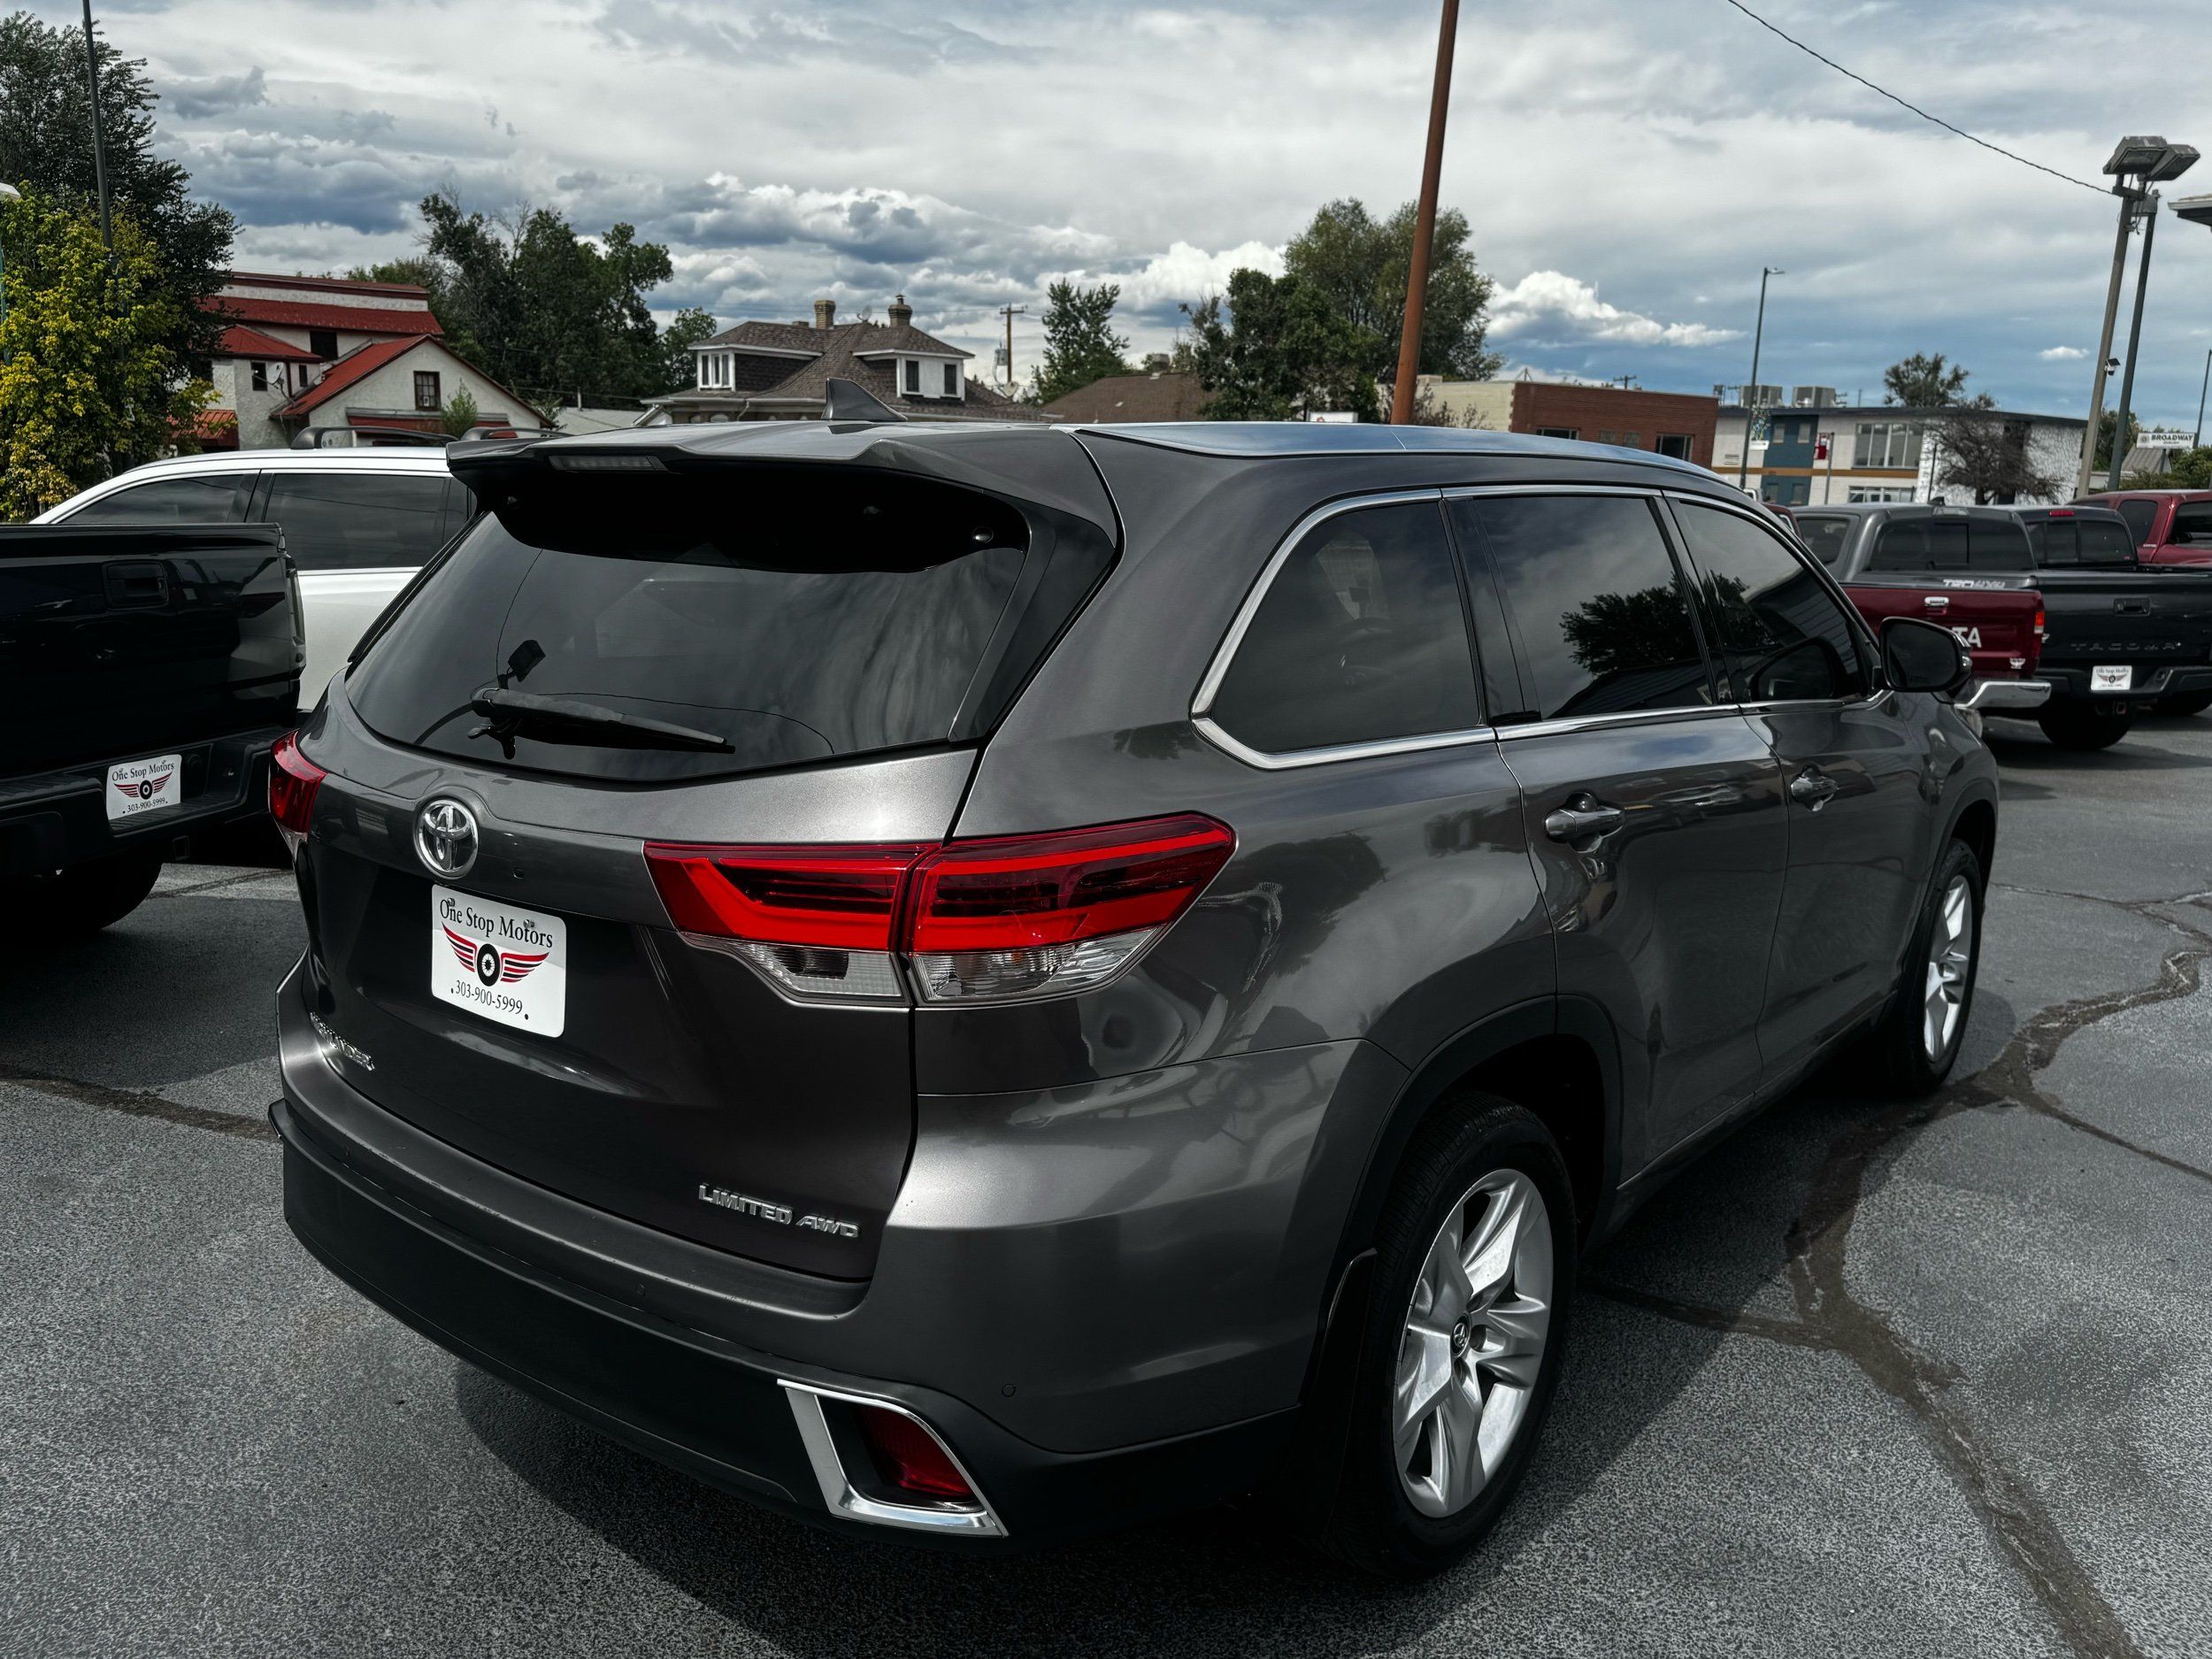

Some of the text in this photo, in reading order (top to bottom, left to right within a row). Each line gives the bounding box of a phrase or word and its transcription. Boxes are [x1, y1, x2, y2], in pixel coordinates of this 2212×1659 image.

[111, 763, 174, 781] One Stop Motors
[127, 796, 165, 813] 303-900-5999
[440, 899, 553, 949] One Stop Motors
[455, 979, 523, 1015] 303-900-5999
[698, 1183, 862, 1238] LIMITED AWD
